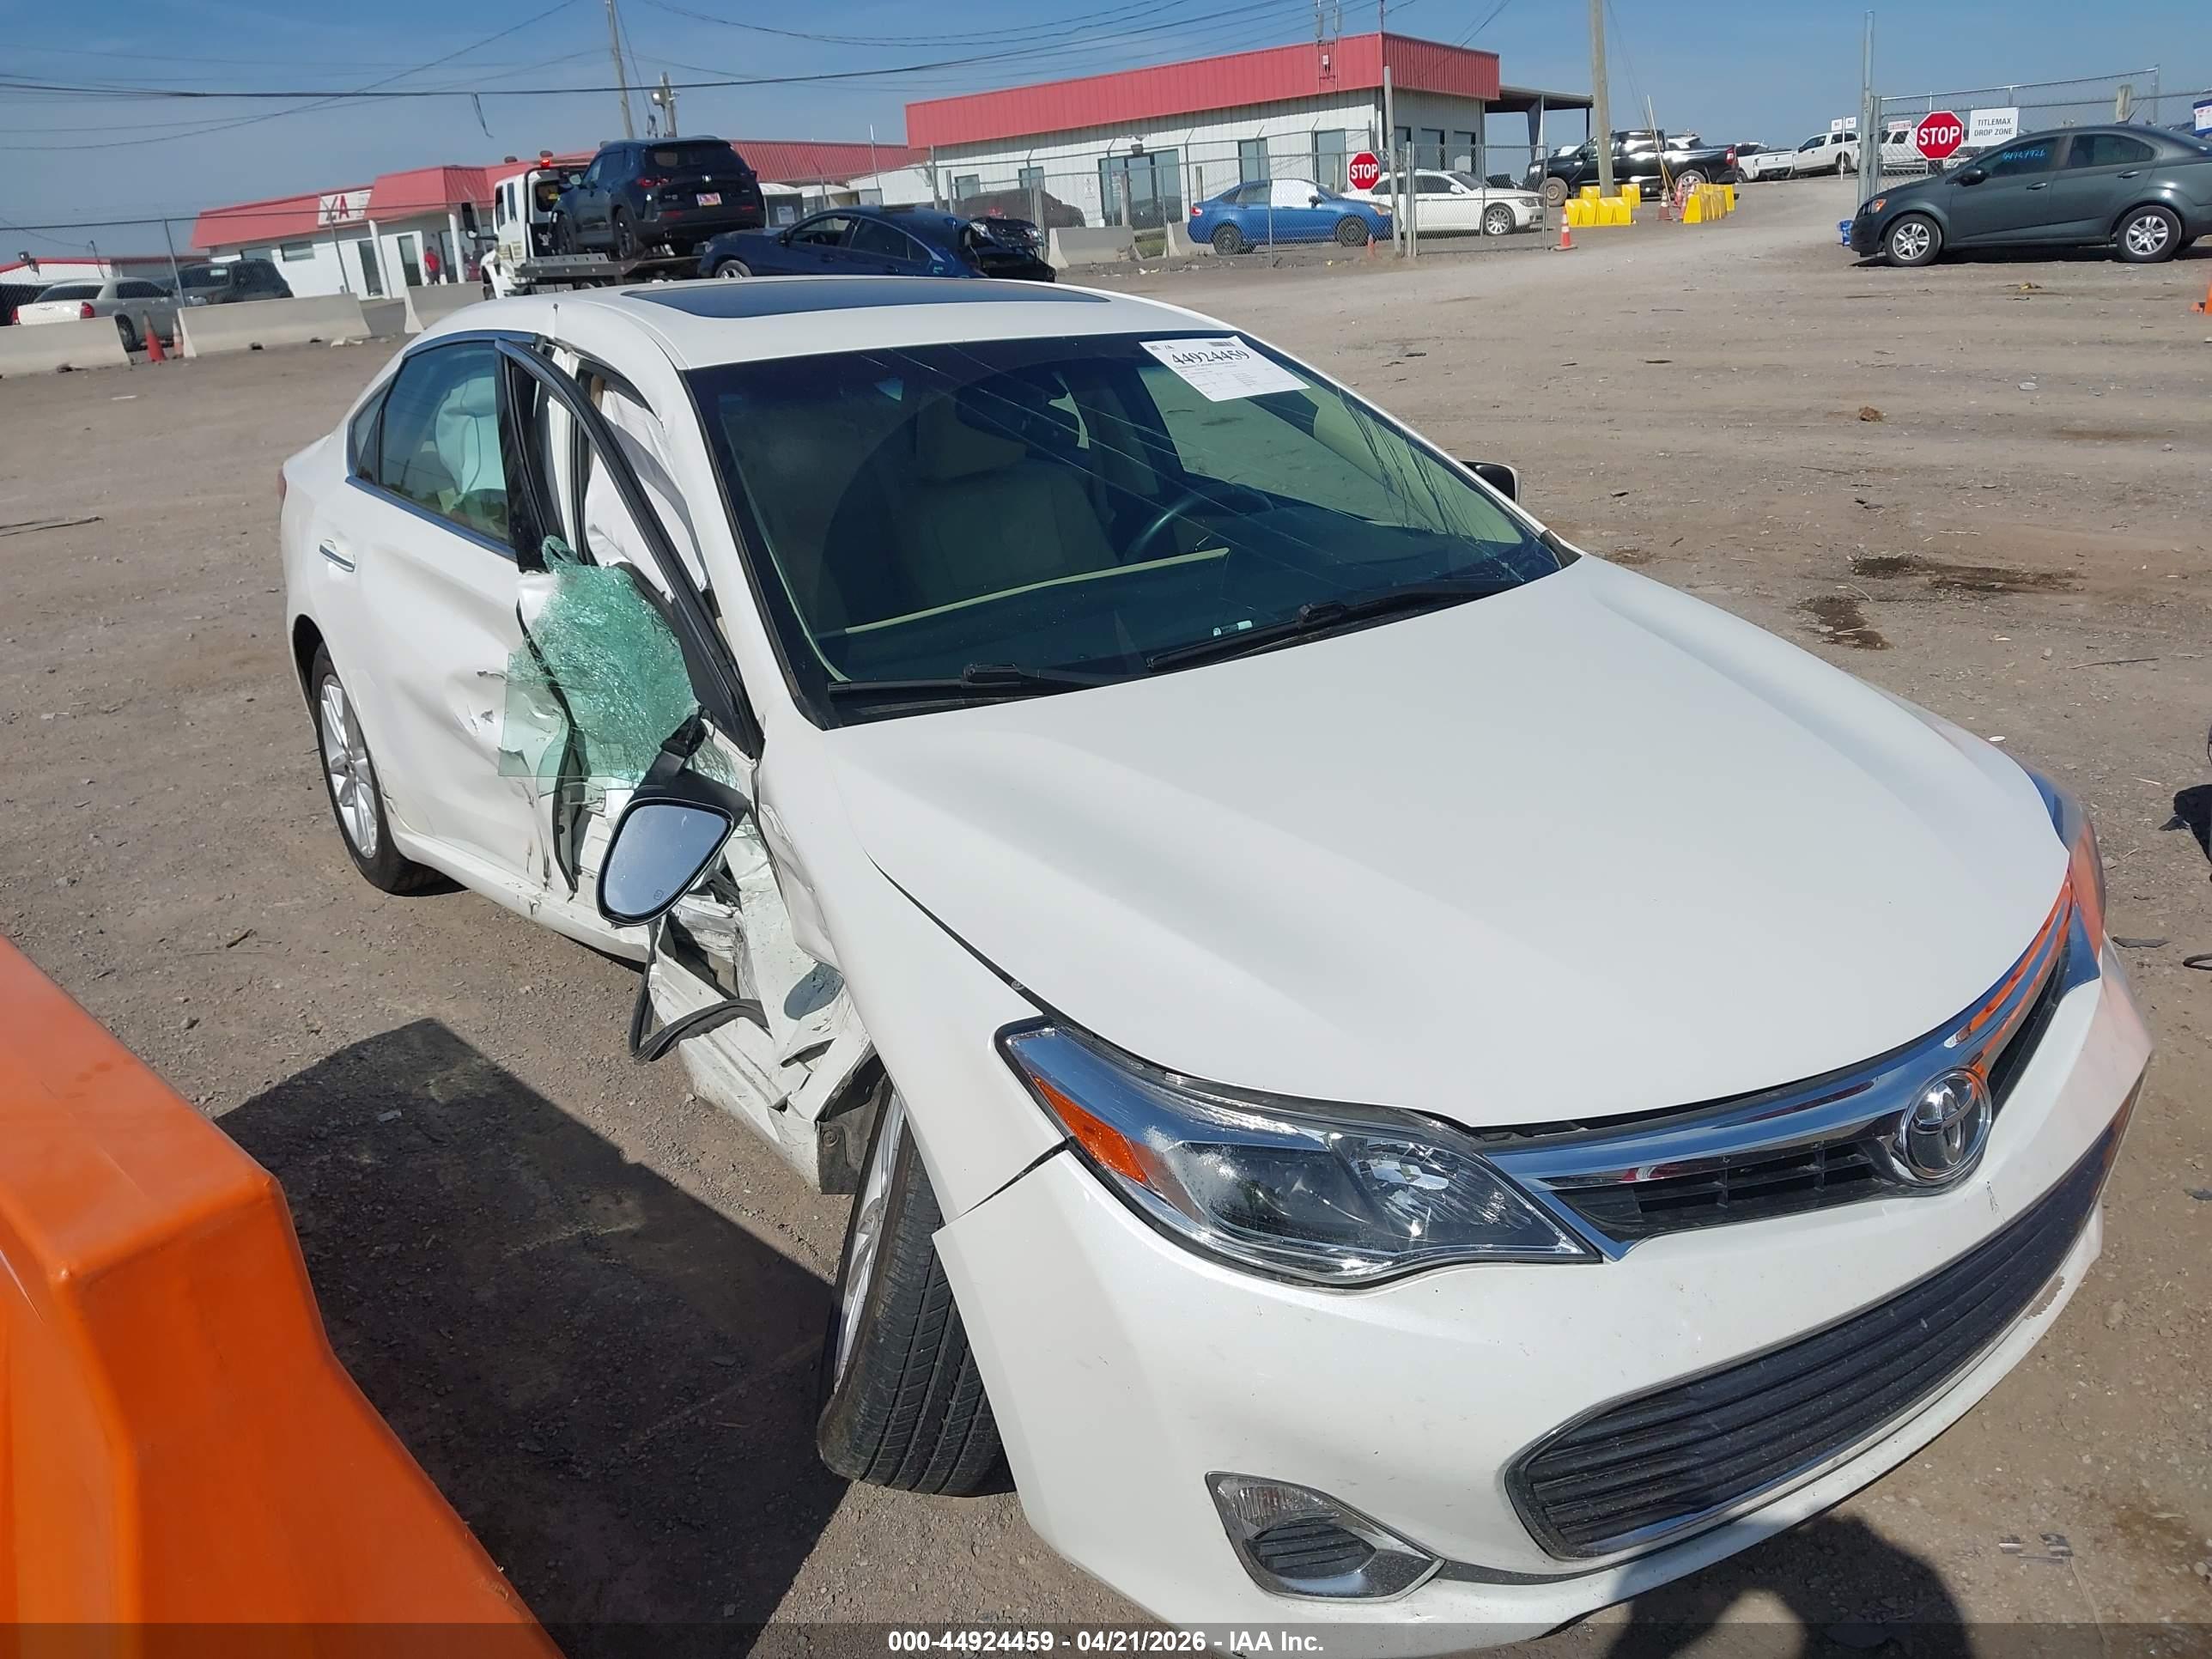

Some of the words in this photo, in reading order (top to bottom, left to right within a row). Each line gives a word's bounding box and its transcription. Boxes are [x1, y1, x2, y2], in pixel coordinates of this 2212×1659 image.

[1978, 117, 2011, 126] TITLEMAX
[1918, 125, 1960, 146] STOP
[1994, 127, 2013, 136] ZONE
[1351, 163, 1378, 179] STOP
[1171, 349, 1250, 365] 44924459
